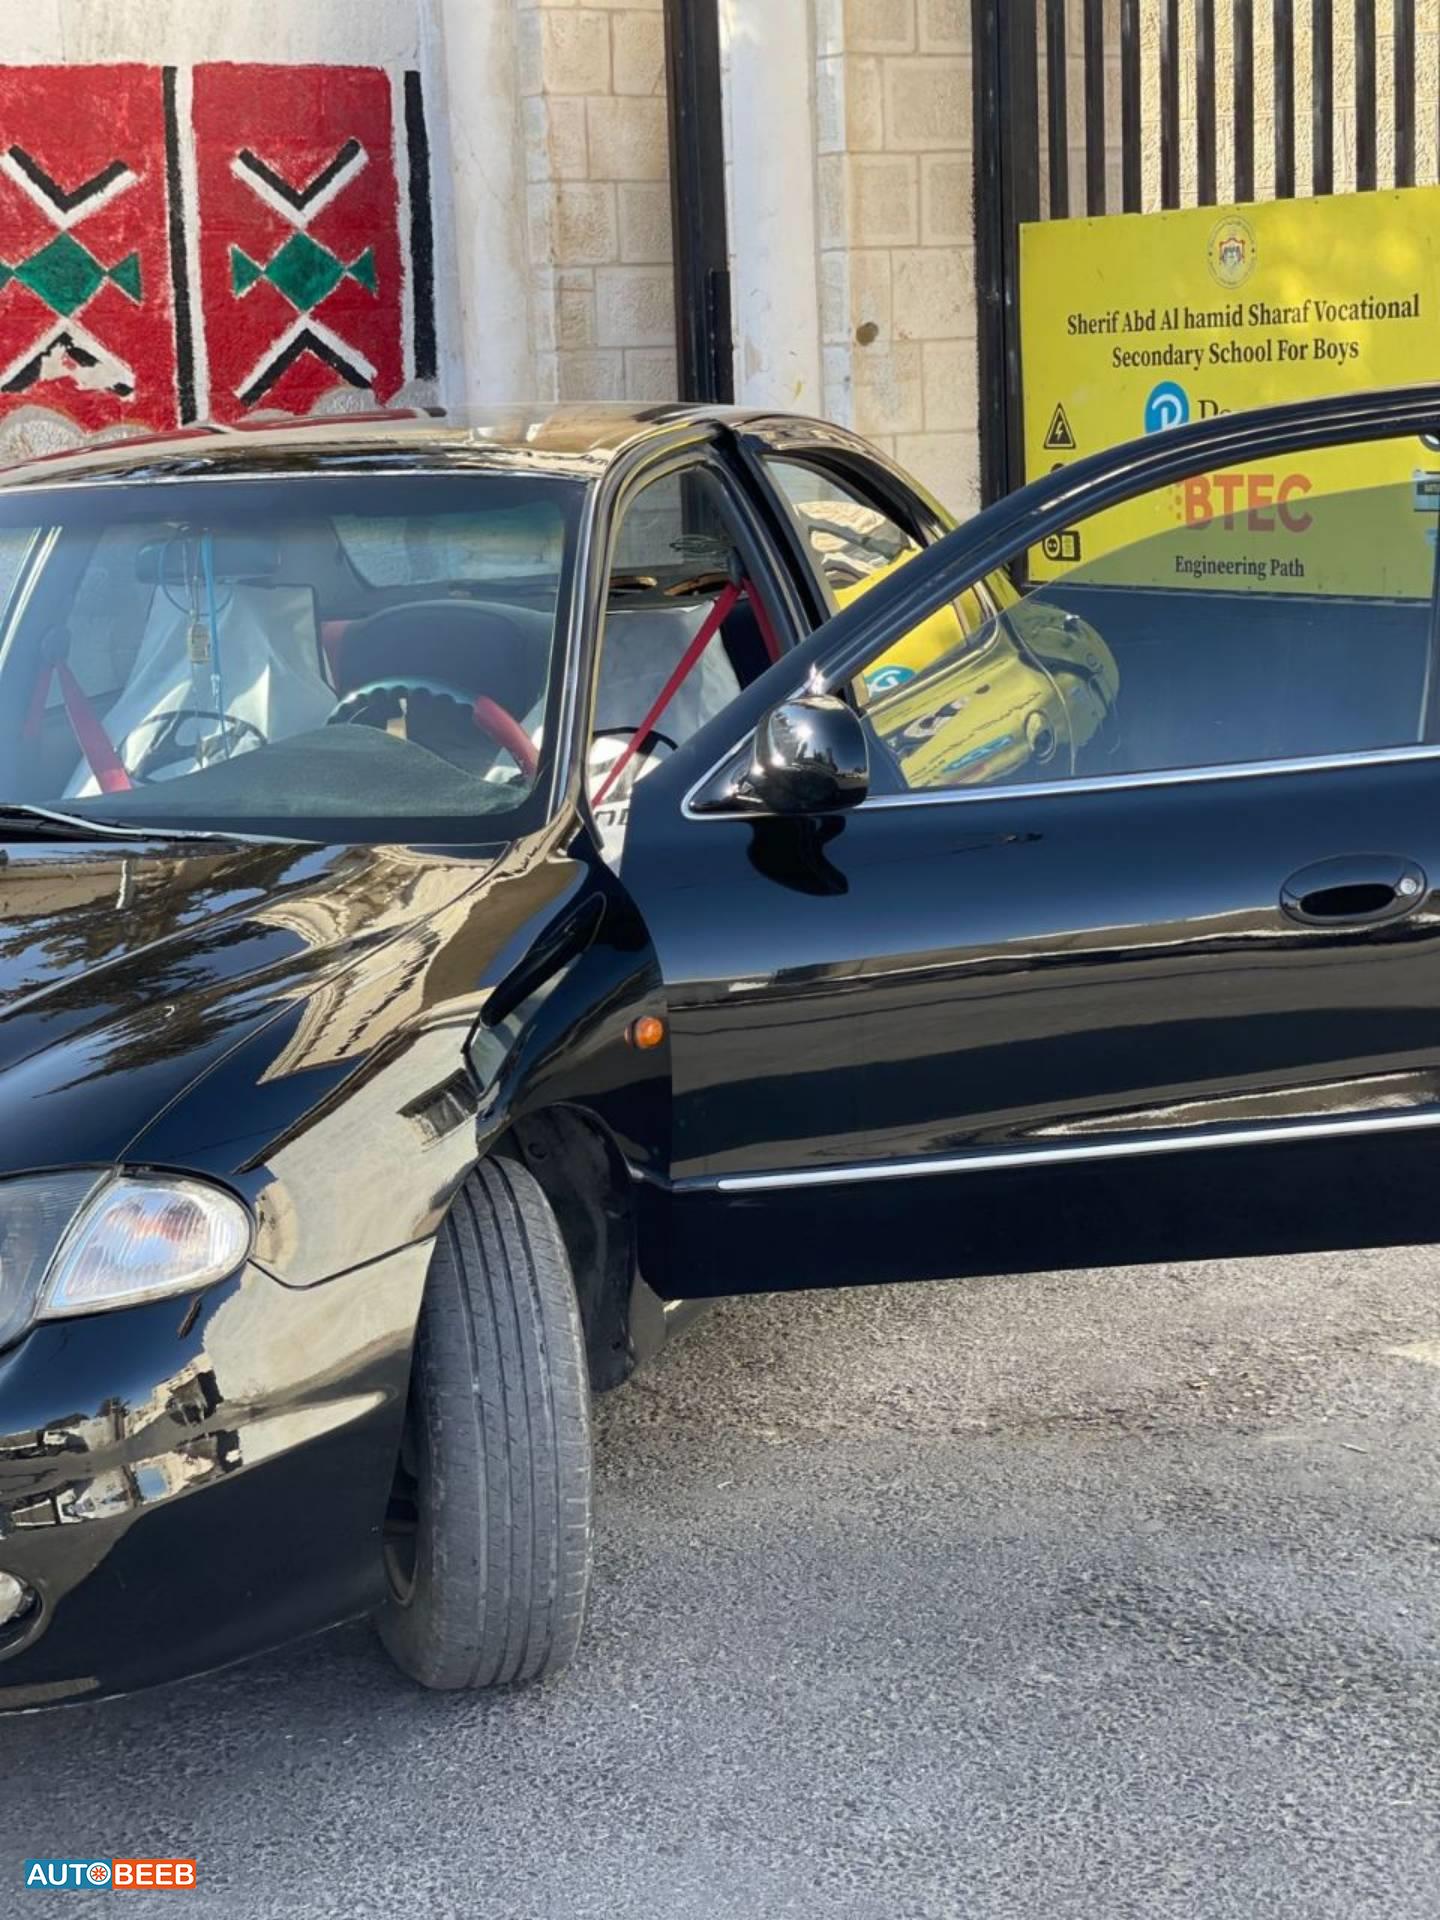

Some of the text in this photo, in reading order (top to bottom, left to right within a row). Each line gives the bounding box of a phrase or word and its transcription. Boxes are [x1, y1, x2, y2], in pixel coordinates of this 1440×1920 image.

[1067, 293, 1420, 335] Sherif Abd Al hamid Sharaf Vocational
[1112, 338, 1360, 371] Secondary School For Boys
[1184, 473, 1313, 533] BTEC
[1175, 555, 1305, 581] Engineering Path
